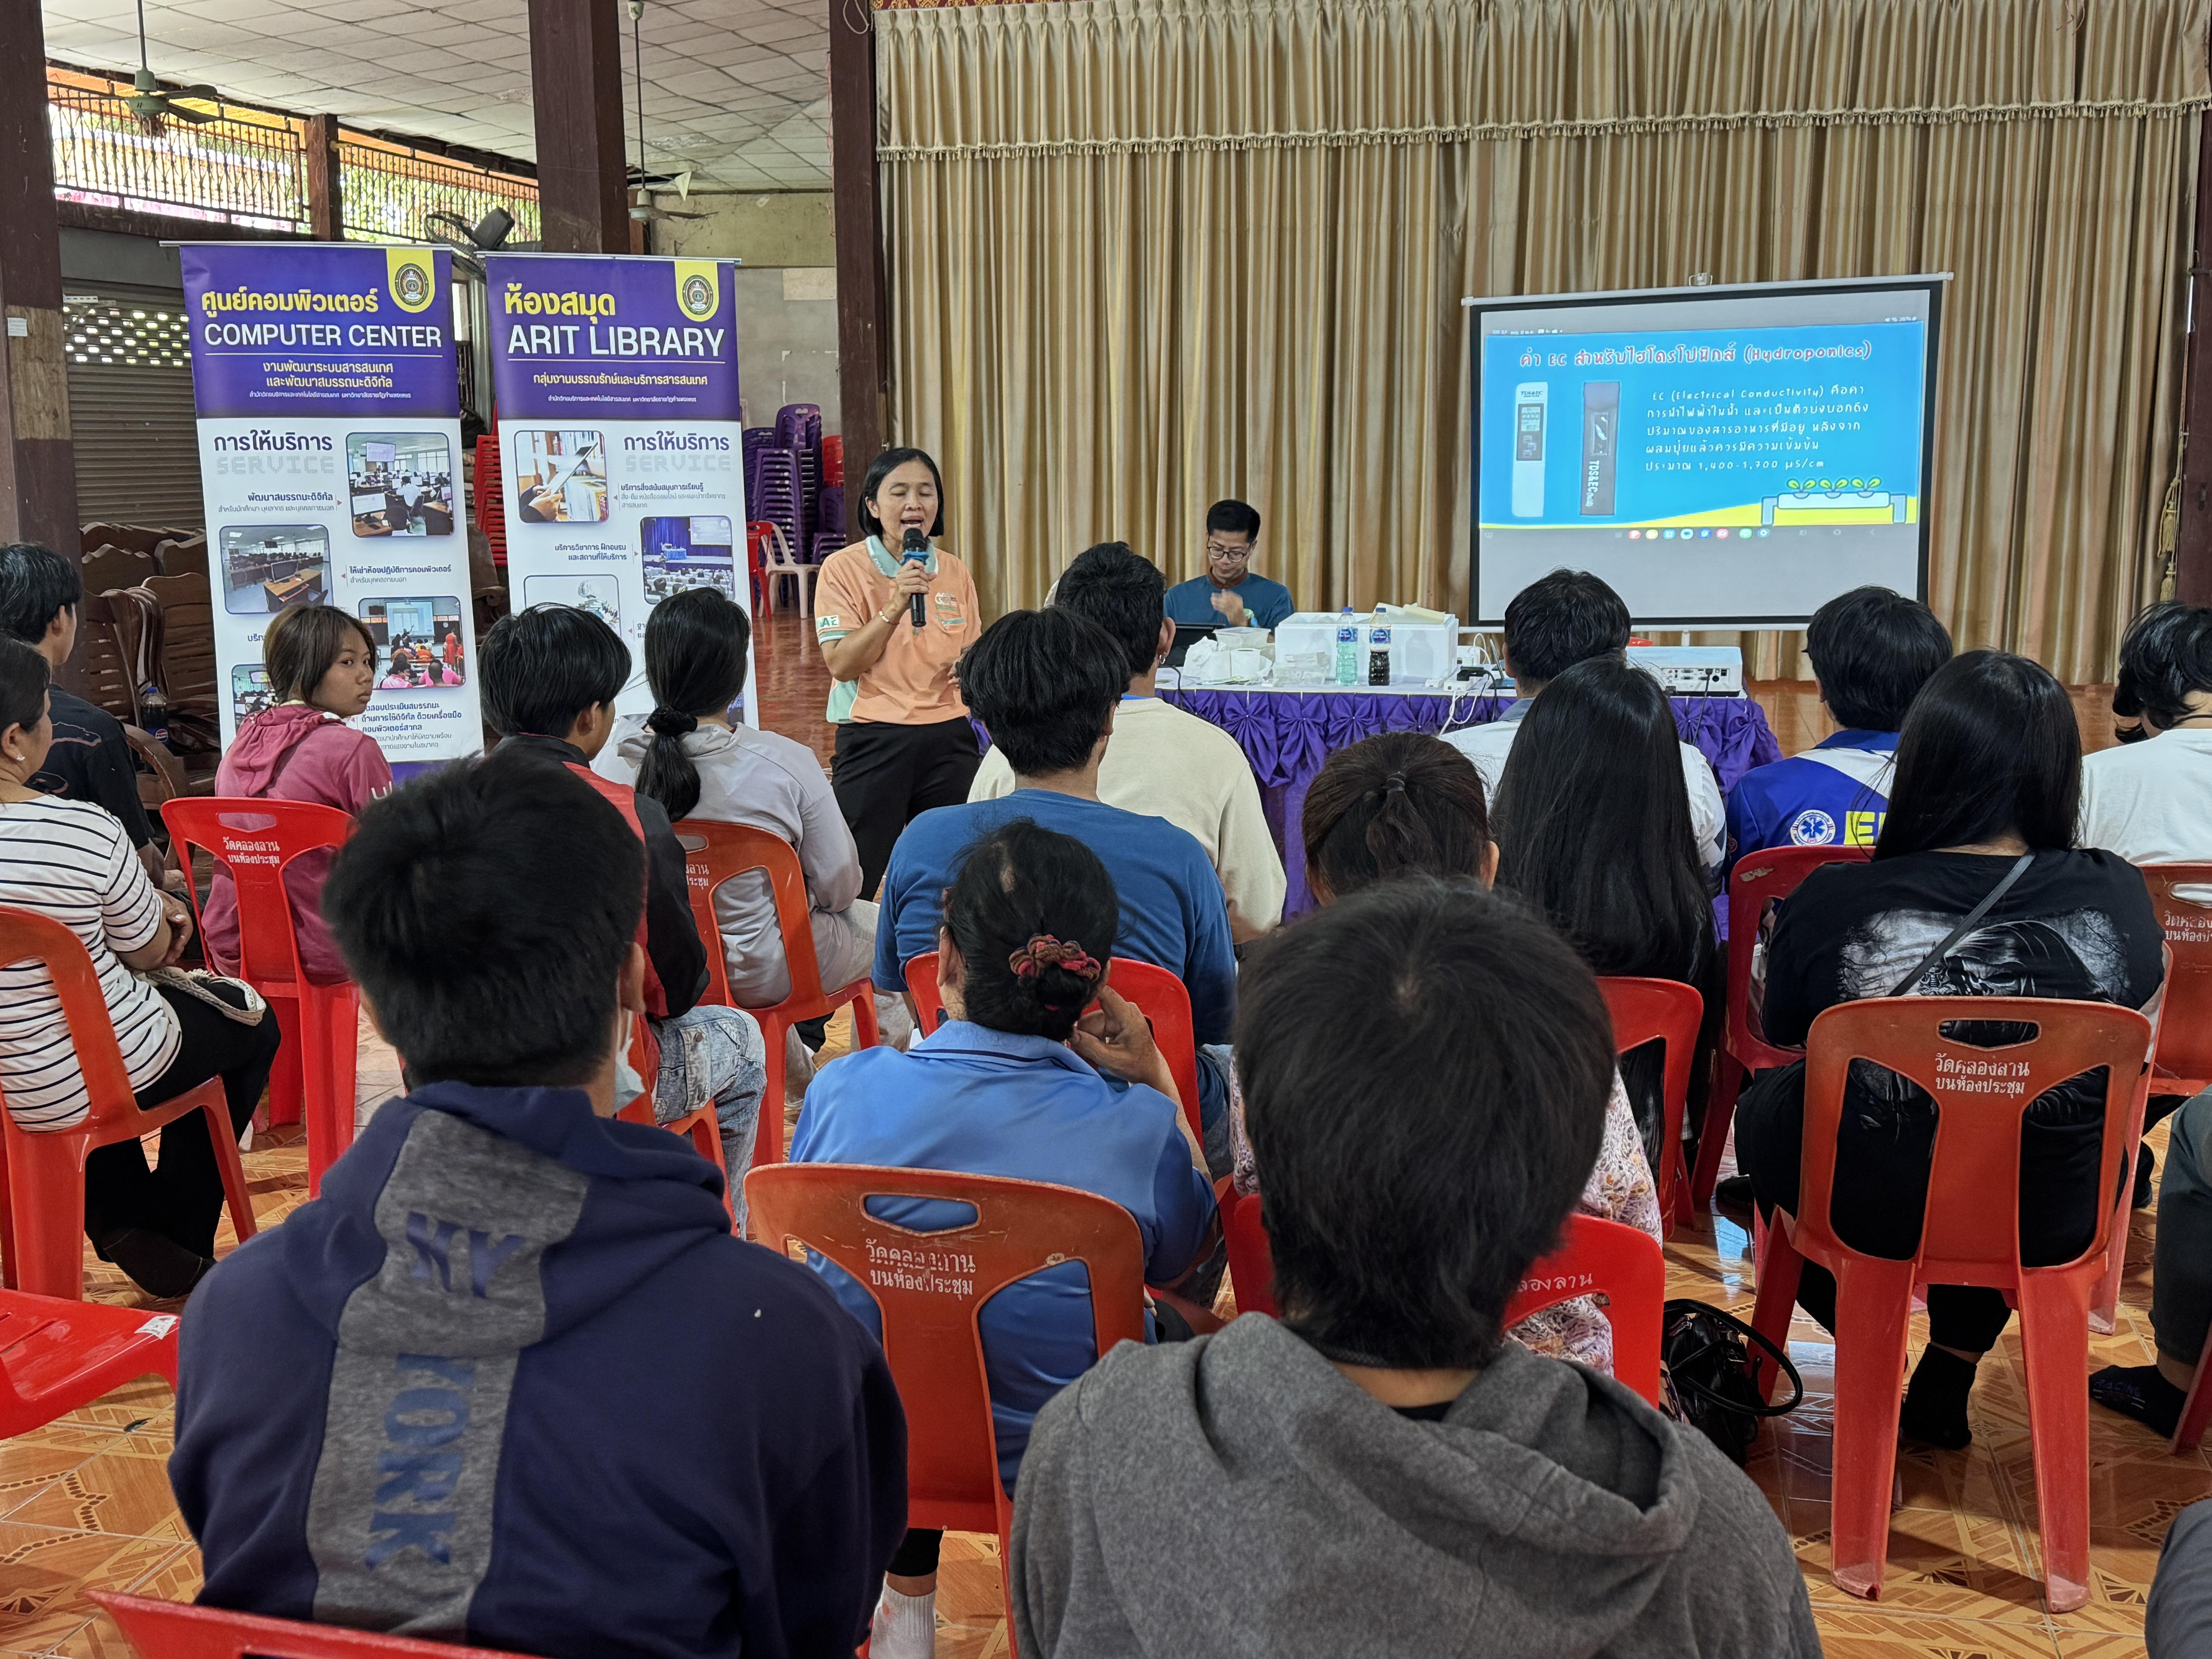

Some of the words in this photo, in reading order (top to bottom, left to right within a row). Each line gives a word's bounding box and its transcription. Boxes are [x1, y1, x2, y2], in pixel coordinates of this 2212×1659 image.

[202, 286, 378, 318] ศูนย์คอมพิวเตอร์
[505, 283, 615, 324] ห้องสมุด
[205, 323, 341, 346] COMPUTER
[349, 325, 442, 347] CENTER
[508, 325, 580, 354] ARIT
[591, 326, 725, 356] LIBRARY
[1548, 353, 1567, 366] EC
[1744, 340, 1872, 364] (Hydroponics)
[263, 359, 393, 373] งานพัฒนาระบบสารสนเทศ
[266, 374, 393, 388] และพัฒนาสมรรถนะดิจิทัล
[534, 372, 708, 387] กลุ่มงานบรรณรักษ์และบริการสารสนเทศ
[1652, 392, 1664, 400] EC
[214, 430, 333, 451] การให้บริการ
[624, 431, 730, 451] การให้บริการ
[216, 455, 335, 475] SERVICE
[625, 454, 731, 472] SERVICE
[227, 852, 280, 867] บนห้องประชุม
[1936, 1075, 2025, 1099] บนห้องประชุม
[1517, 1273, 1593, 1293] ลองลาน
